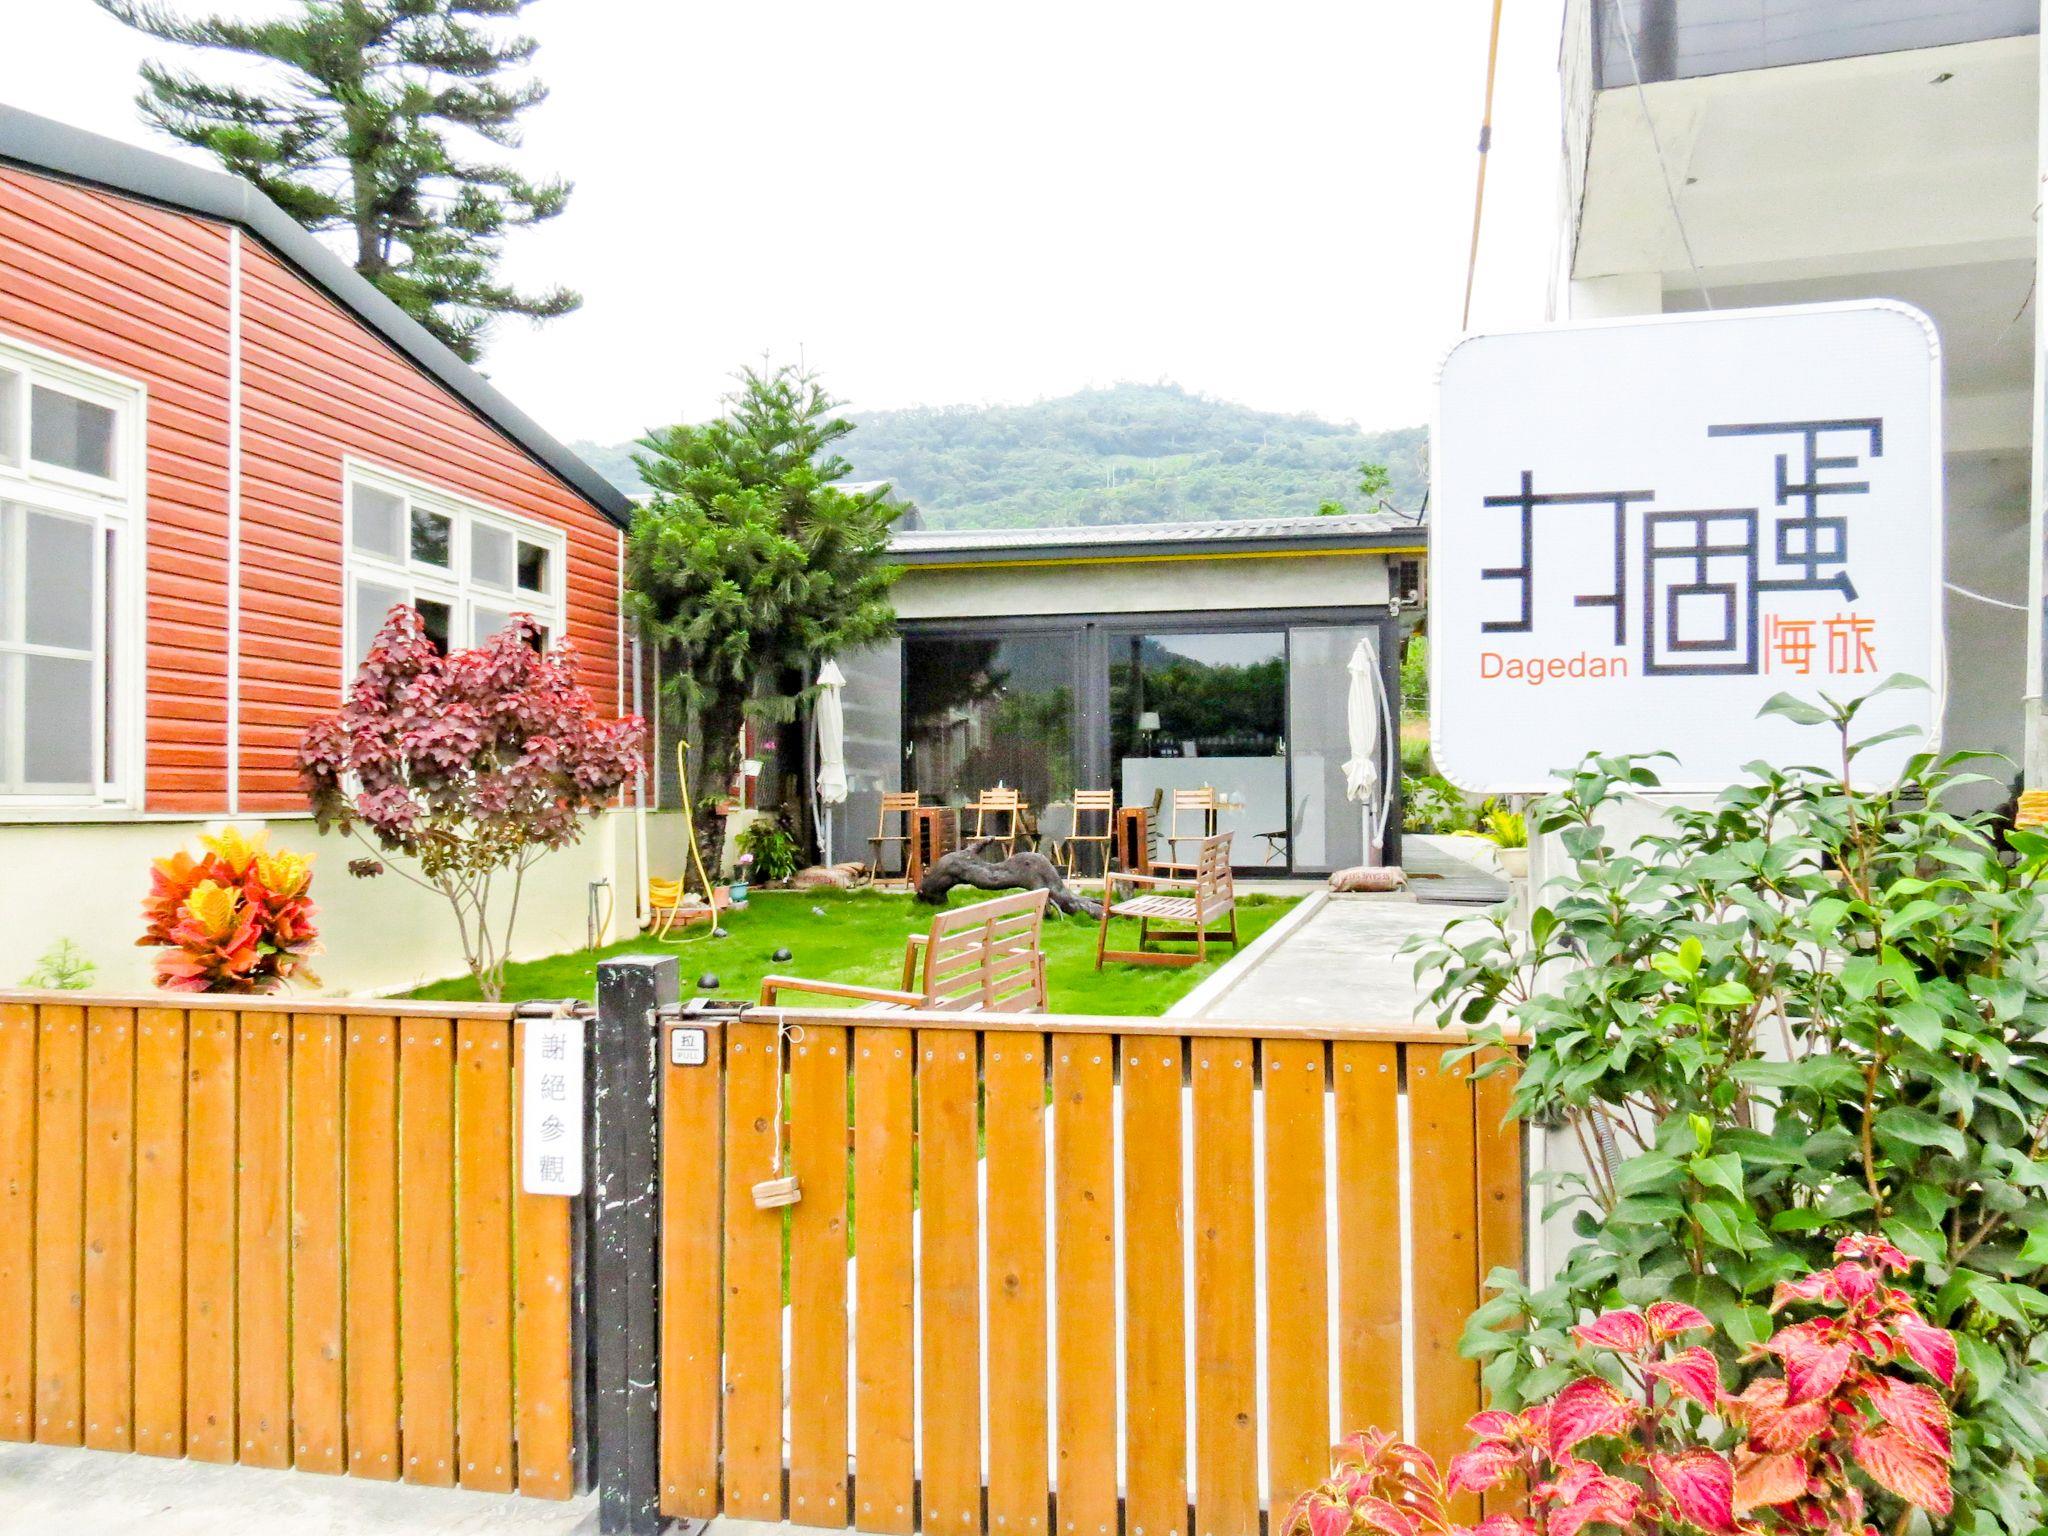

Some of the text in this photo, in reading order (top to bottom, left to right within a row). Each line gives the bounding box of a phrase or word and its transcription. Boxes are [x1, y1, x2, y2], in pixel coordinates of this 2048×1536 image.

[1764, 612, 1878, 675] 海旅
[1480, 651, 1627, 686] Dagedan
[677, 1052, 699, 1060] PULL
[680, 1035, 696, 1047] 拉
[539, 1033, 567, 1183] 謝絕參觀
